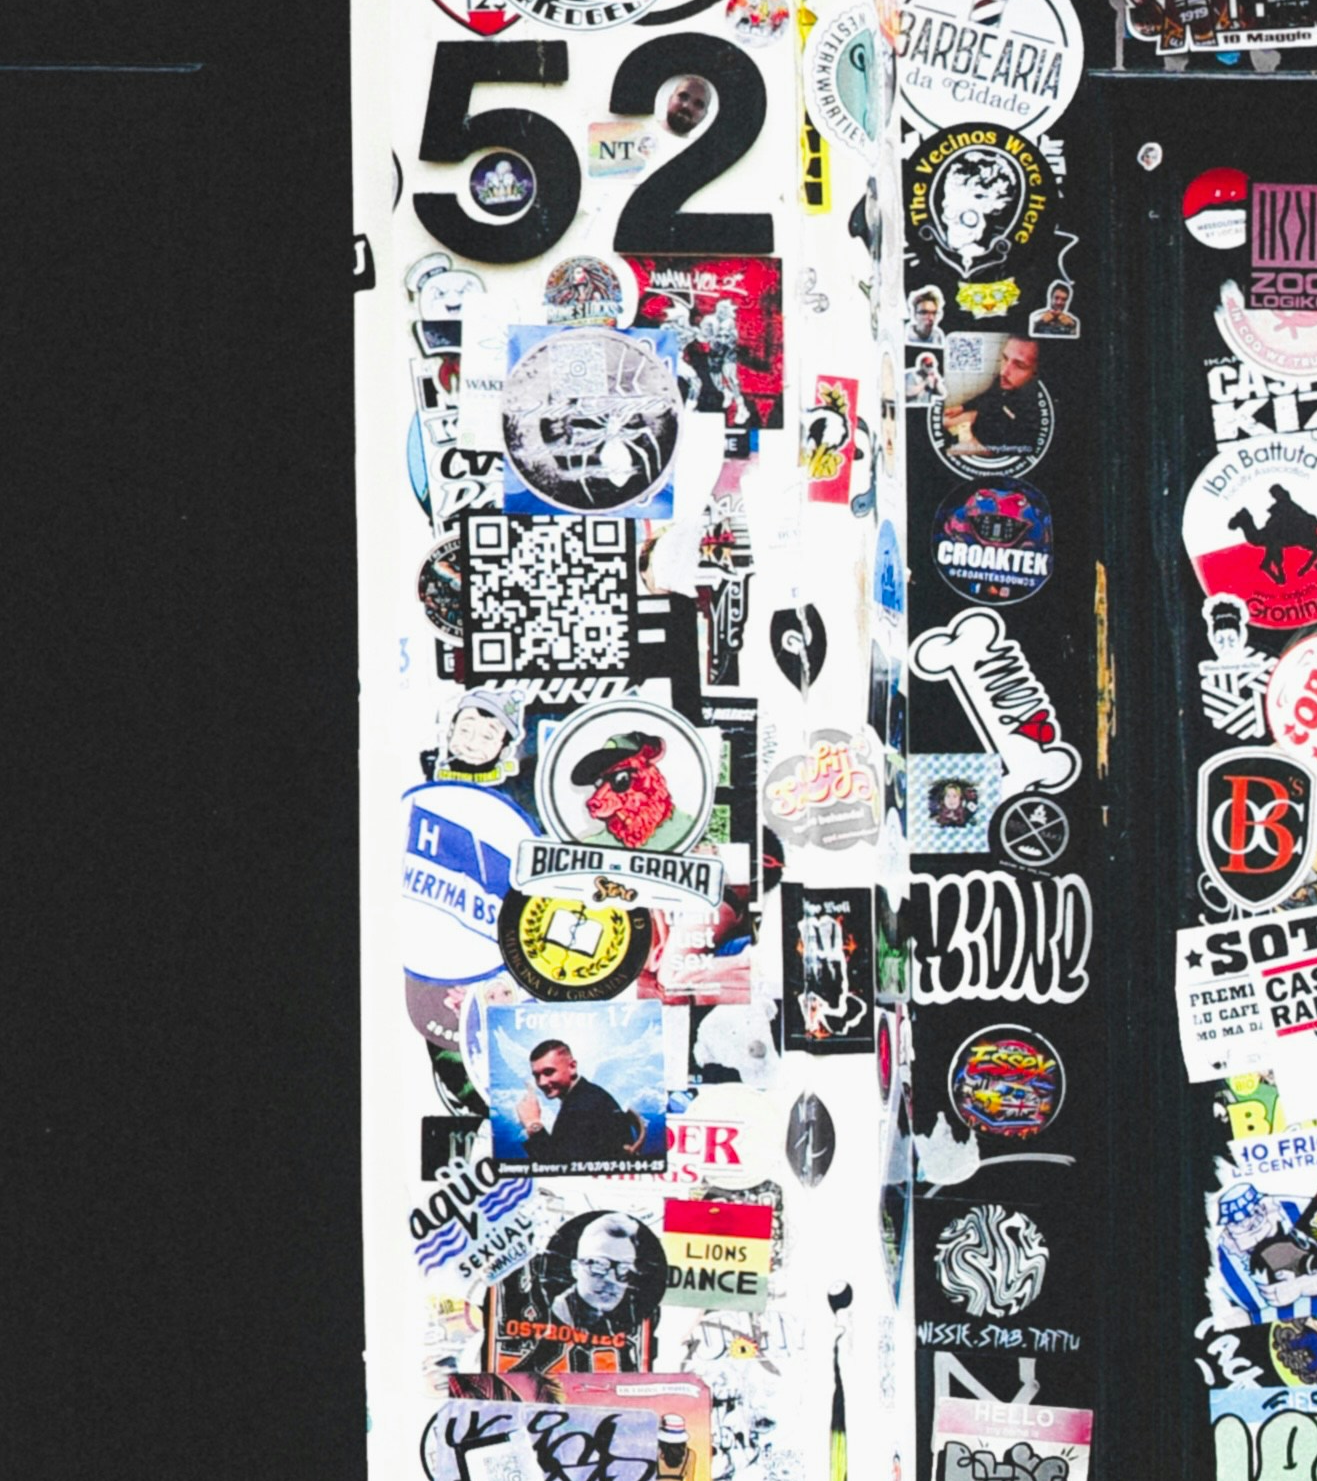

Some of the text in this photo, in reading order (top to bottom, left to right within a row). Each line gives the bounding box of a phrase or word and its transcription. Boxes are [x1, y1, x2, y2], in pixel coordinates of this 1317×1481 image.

[906, 69, 1033, 117] da Cidade
[414, 32, 774, 264] 52
[909, 128, 1047, 245] The Vecinos Were Here
[1203, 462, 1237, 500] Ibn
[936, 540, 1050, 577] CROAKTEK
[530, 847, 711, 896] BICHO GRAXA
[684, 1241, 748, 1263] LIONS
[666, 1266, 758, 1295] DANCE
[974, 1402, 1055, 1429] HELLO
